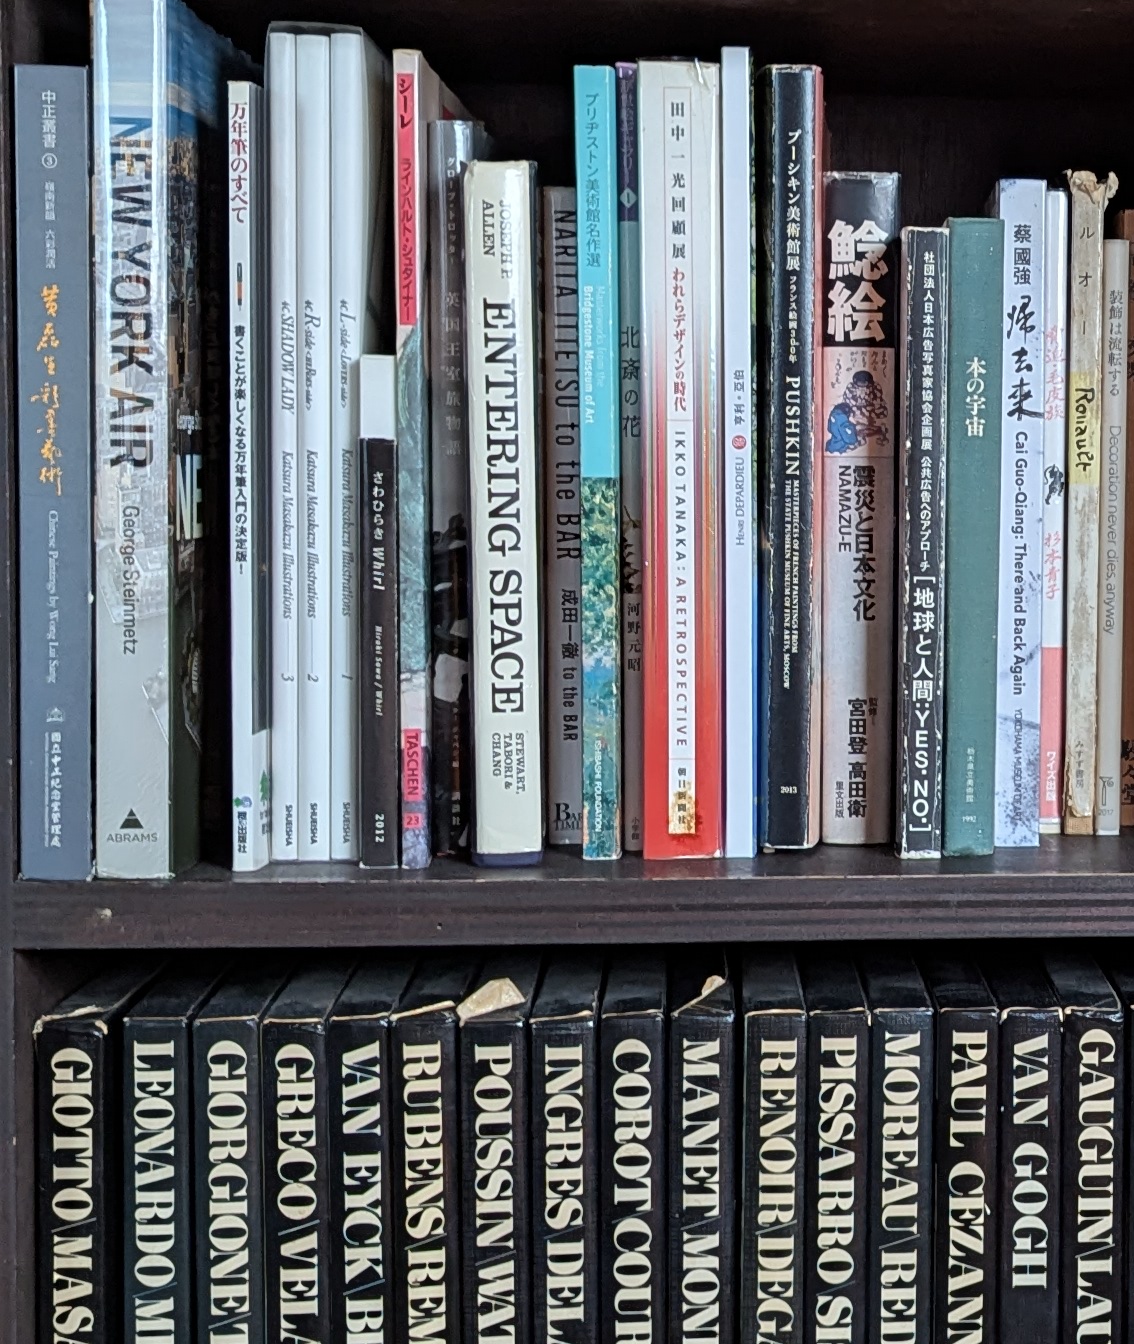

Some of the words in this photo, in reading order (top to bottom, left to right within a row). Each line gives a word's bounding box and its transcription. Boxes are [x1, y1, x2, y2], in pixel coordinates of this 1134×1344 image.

[398, 79, 414, 129] シーレ
[110, 117, 153, 228] NEW
[230, 103, 249, 224] 万年筆のすべて
[585, 93, 602, 268] ブリヂストン美術館名作選
[671, 101, 687, 260] 田中一光回顧展
[786, 129, 802, 271] プーシキン美術館展
[827, 219, 889, 343] 鯰絵
[1013, 224, 1032, 286] 蔡國強
[110, 241, 154, 375] YORK
[1108, 290, 1124, 397] 装飾は流転する
[621, 325, 641, 439] 北斎の花
[785, 376, 800, 476] PUSHKIN
[965, 356, 986, 438] 本の宇宙
[109, 388, 155, 469] AIR
[483, 297, 522, 557] ENTERING
[1014, 431, 1029, 456] Cai
[119, 505, 140, 565] George
[372, 470, 385, 541] さわひらき
[838, 465, 852, 553] NAMAZU-E
[852, 464, 877, 623] 震災と日本文化
[372, 546, 386, 591] Whirl
[1012, 543, 1028, 583] There
[1012, 587, 1026, 613] and
[122, 569, 140, 655] Steinmetz
[488, 569, 525, 714] SPACE
[1012, 618, 1026, 652] Back
[675, 594, 688, 747] RETROSPECTIVE
[1011, 655, 1026, 696] Again
[405, 732, 421, 796] TASCHEN
[847, 697, 869, 756] 宮田登
[106, 832, 158, 843] ABRAMS
[374, 813, 385, 843] 2012
[406, 814, 420, 826] 23
[342, 1041, 382, 1137] VAN
[949, 1029, 988, 1148] PAUL
[1012, 1032, 1050, 1128] VAN
[1012, 1141, 1050, 1290] GOGH
